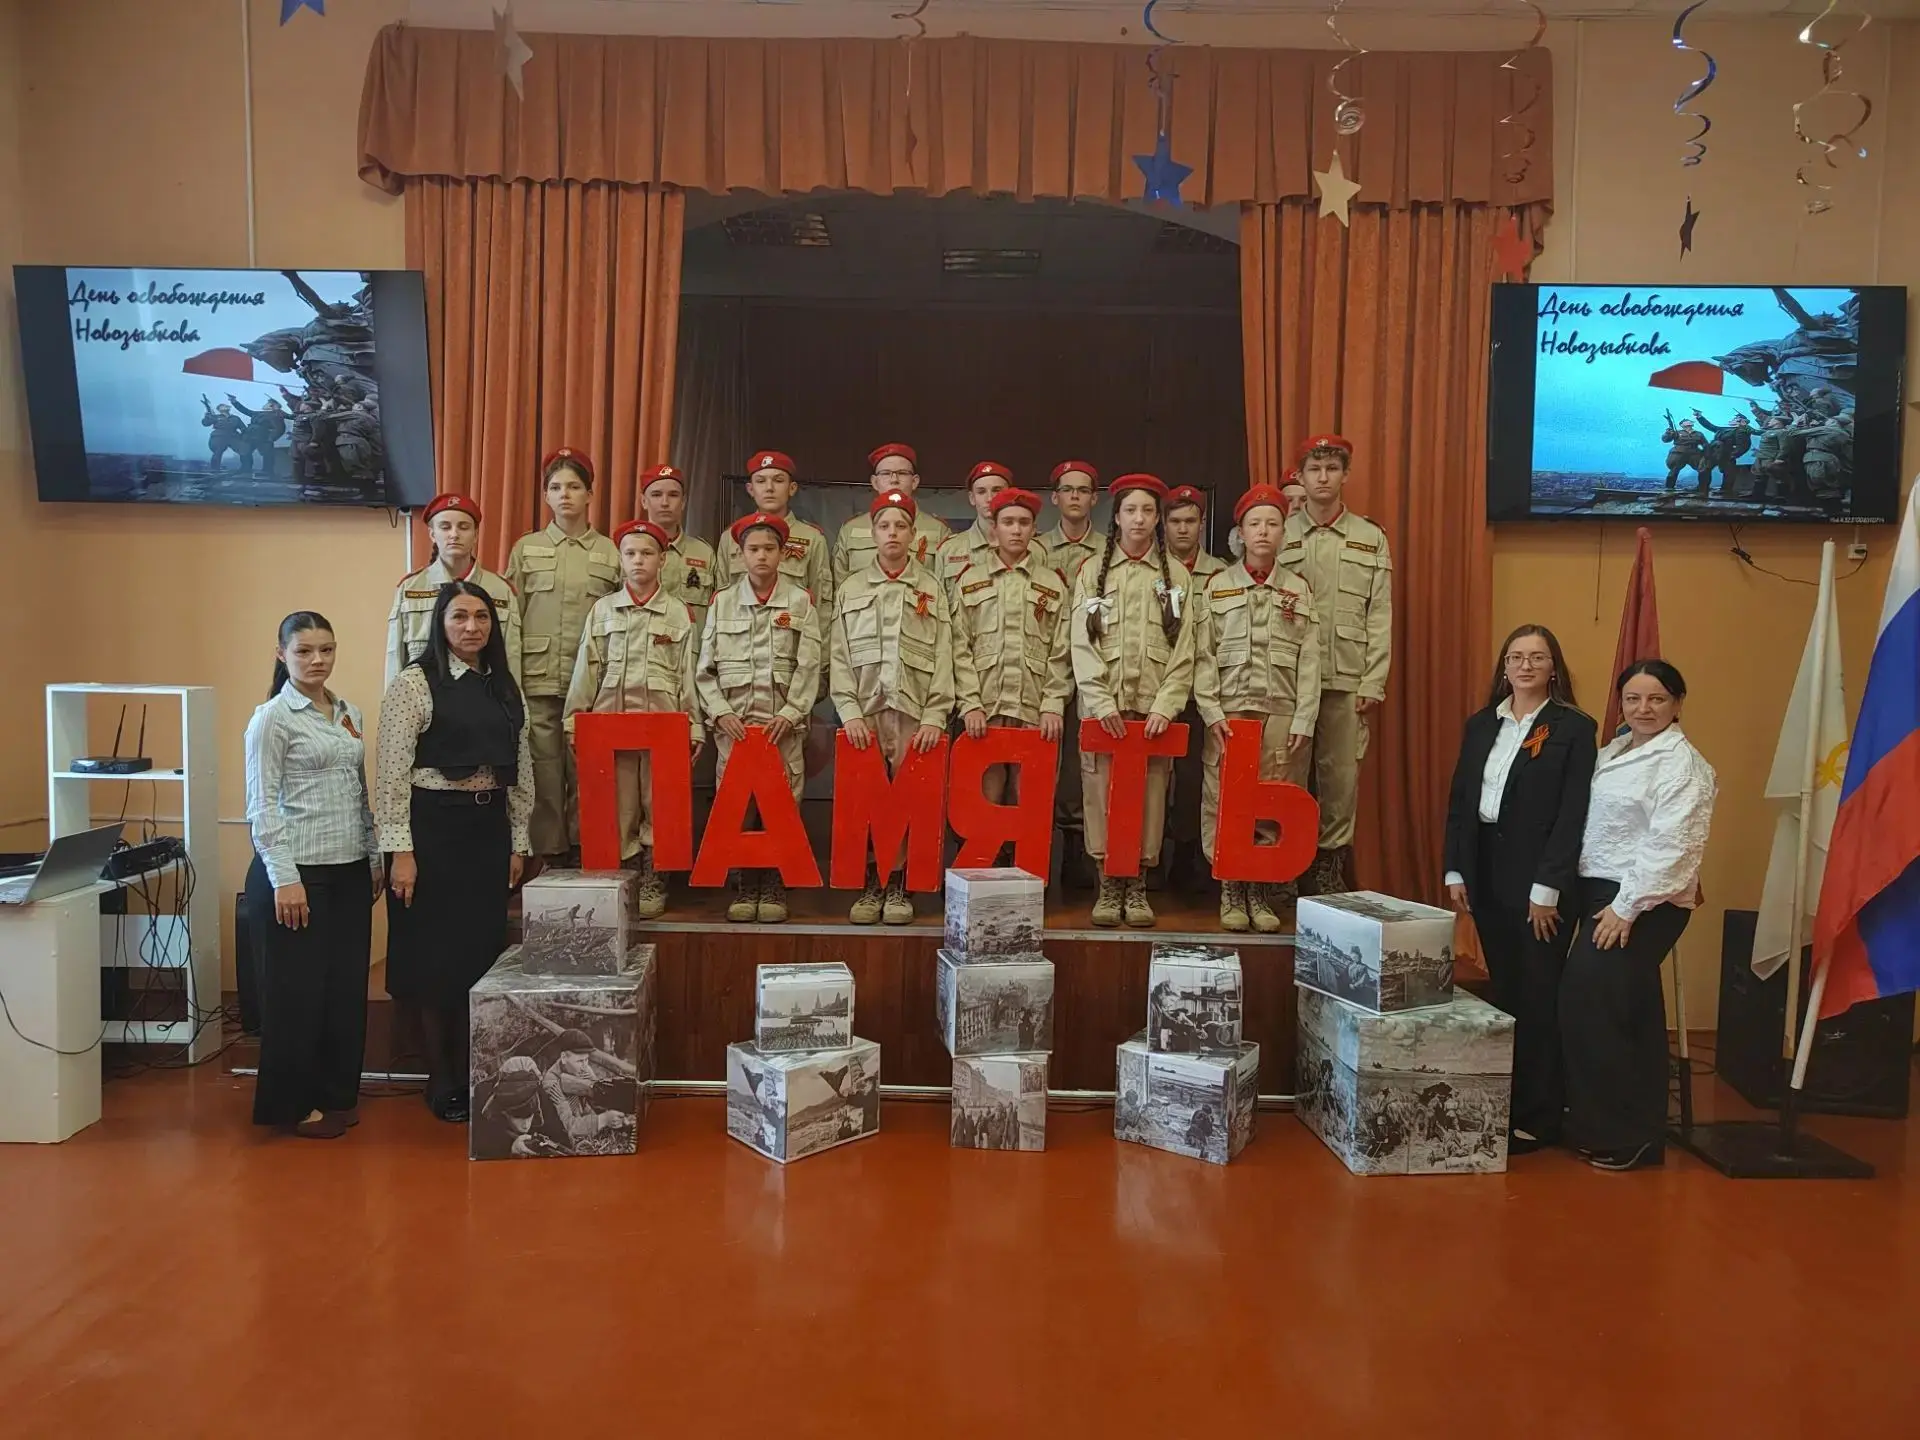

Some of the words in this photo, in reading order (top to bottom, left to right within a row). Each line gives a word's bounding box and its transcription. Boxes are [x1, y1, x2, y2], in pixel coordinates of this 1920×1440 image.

[70, 280, 120, 312] День
[127, 281, 265, 313] освобождения
[1538, 292, 1592, 324] День
[1599, 292, 1744, 325] освобождения
[76, 318, 200, 350] Новозыбкова
[1541, 330, 1671, 363] Новозыбкова
[574, 711, 1320, 892] ПАМЯТЬ
